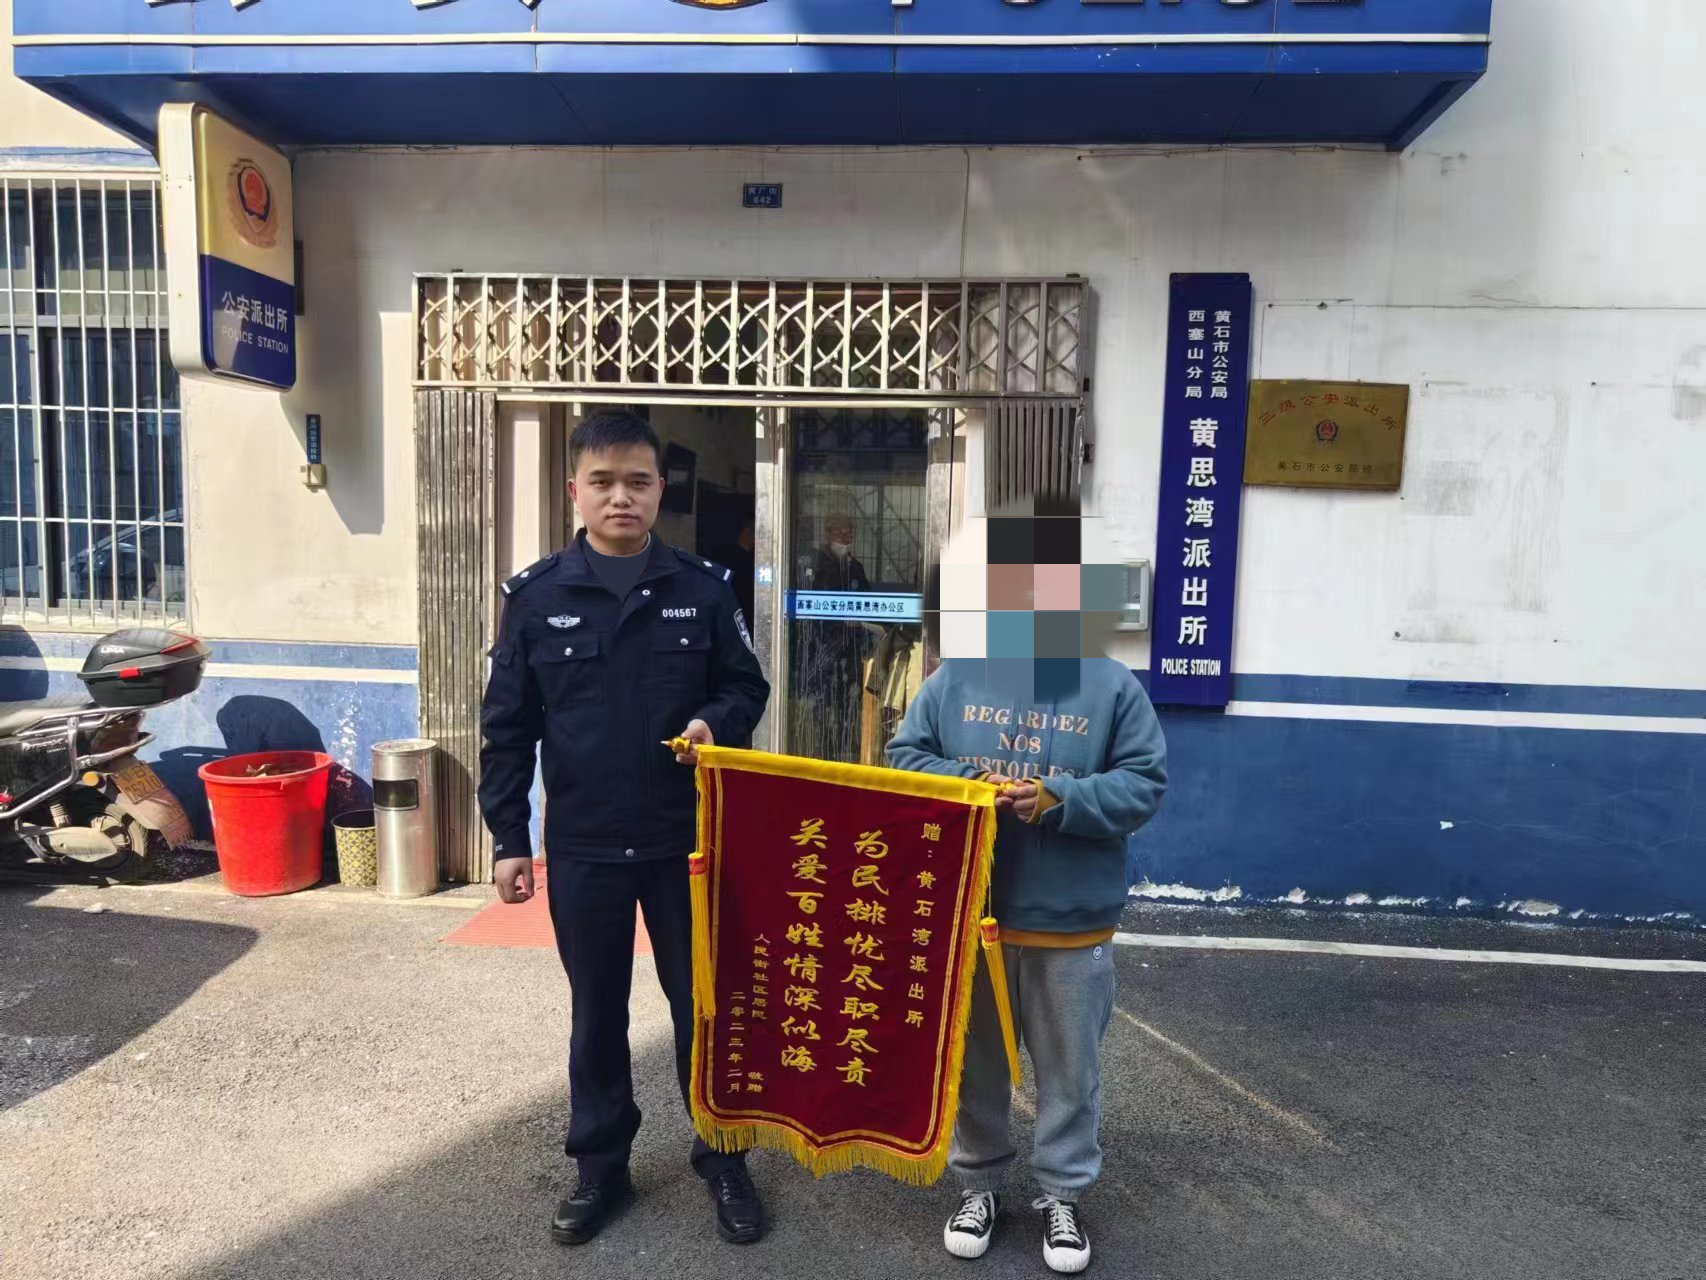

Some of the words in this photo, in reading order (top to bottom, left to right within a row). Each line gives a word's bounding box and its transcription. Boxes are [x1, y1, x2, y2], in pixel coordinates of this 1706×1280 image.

[222, 291, 288, 333] 公安派出所
[222, 326, 253, 345] POLICE
[257, 335, 288, 353] STATION
[1185, 310, 1206, 399] 西塞山分局
[1210, 310, 1232, 399] 黄石市公安局
[1177, 418, 1218, 645] 黄思湾派出所
[662, 608, 697, 618] 004567
[1161, 658, 1188, 675] POLICE
[1190, 659, 1221, 676] STATION
[997, 733, 1041, 754] NOS
[781, 817, 828, 1072] 关爱百姓情深似海
[836, 829, 889, 1087] 为民排忧尽职尽责
[727, 991, 746, 1093] 二零二三年二月
